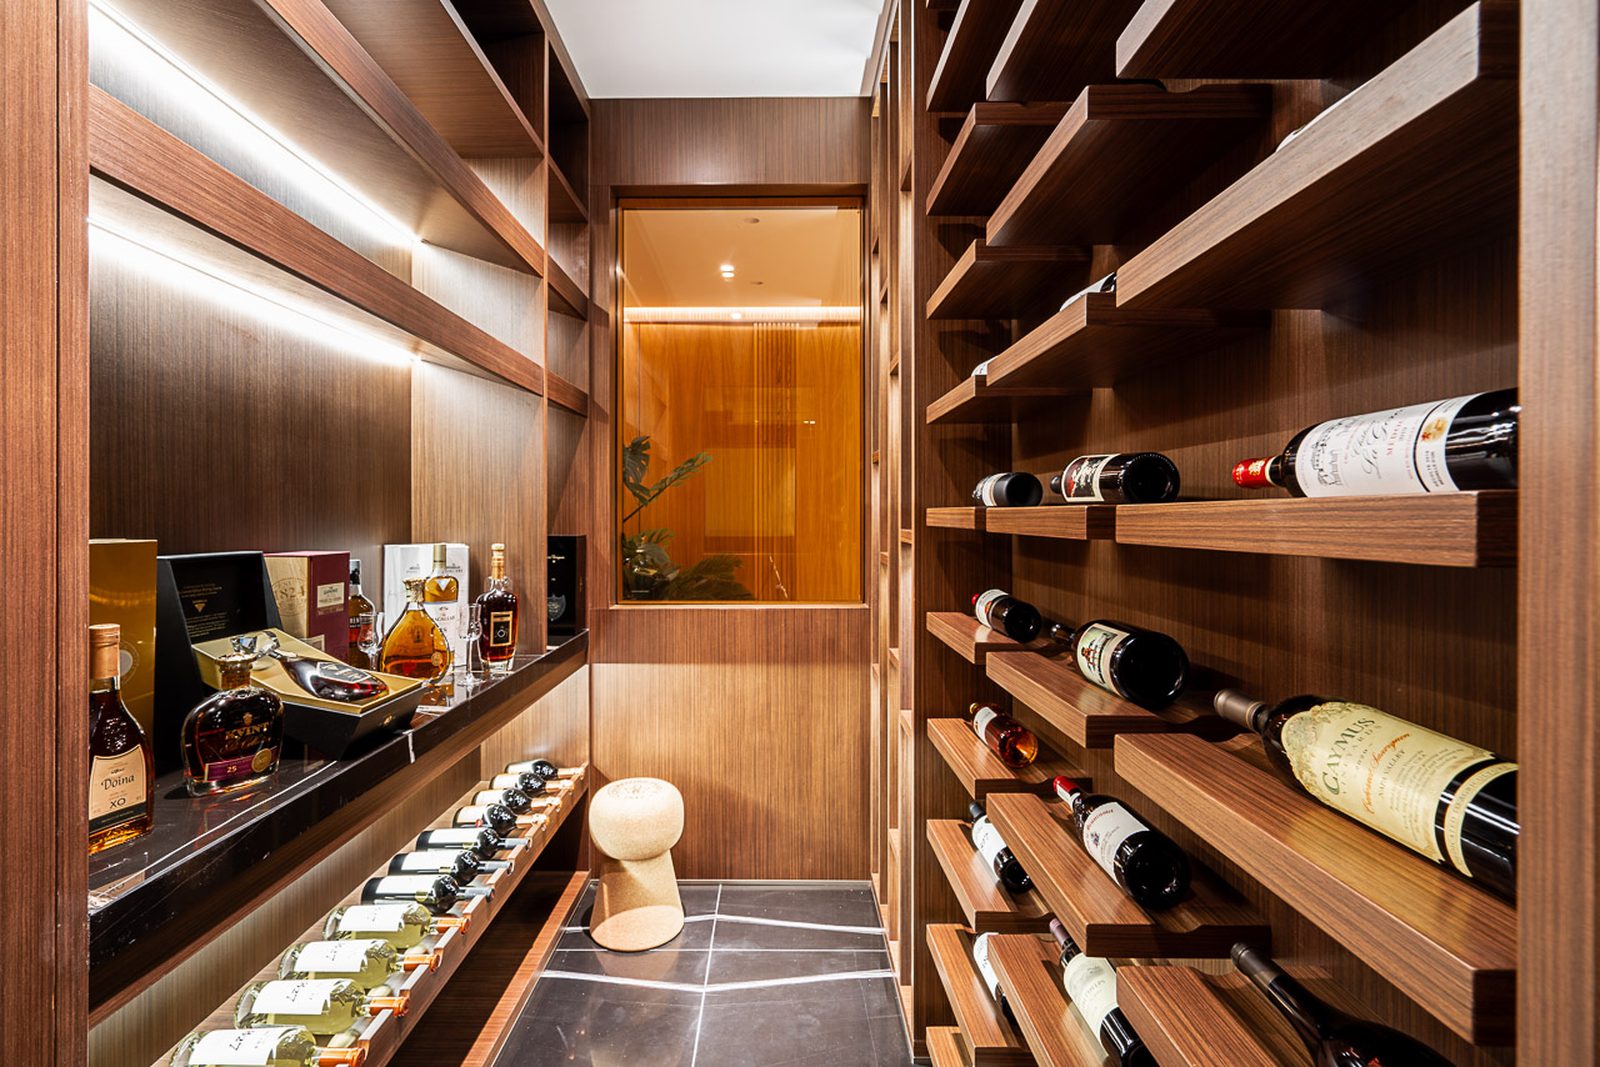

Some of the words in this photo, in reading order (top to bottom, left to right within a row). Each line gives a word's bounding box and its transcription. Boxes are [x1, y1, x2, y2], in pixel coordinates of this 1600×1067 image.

[225, 722, 269, 740] KVINT
[1322, 718, 1375, 795] CAYMUS
[226, 765, 238, 774] 25
[100, 774, 135, 791] Doina
[109, 797, 126, 809] XO
